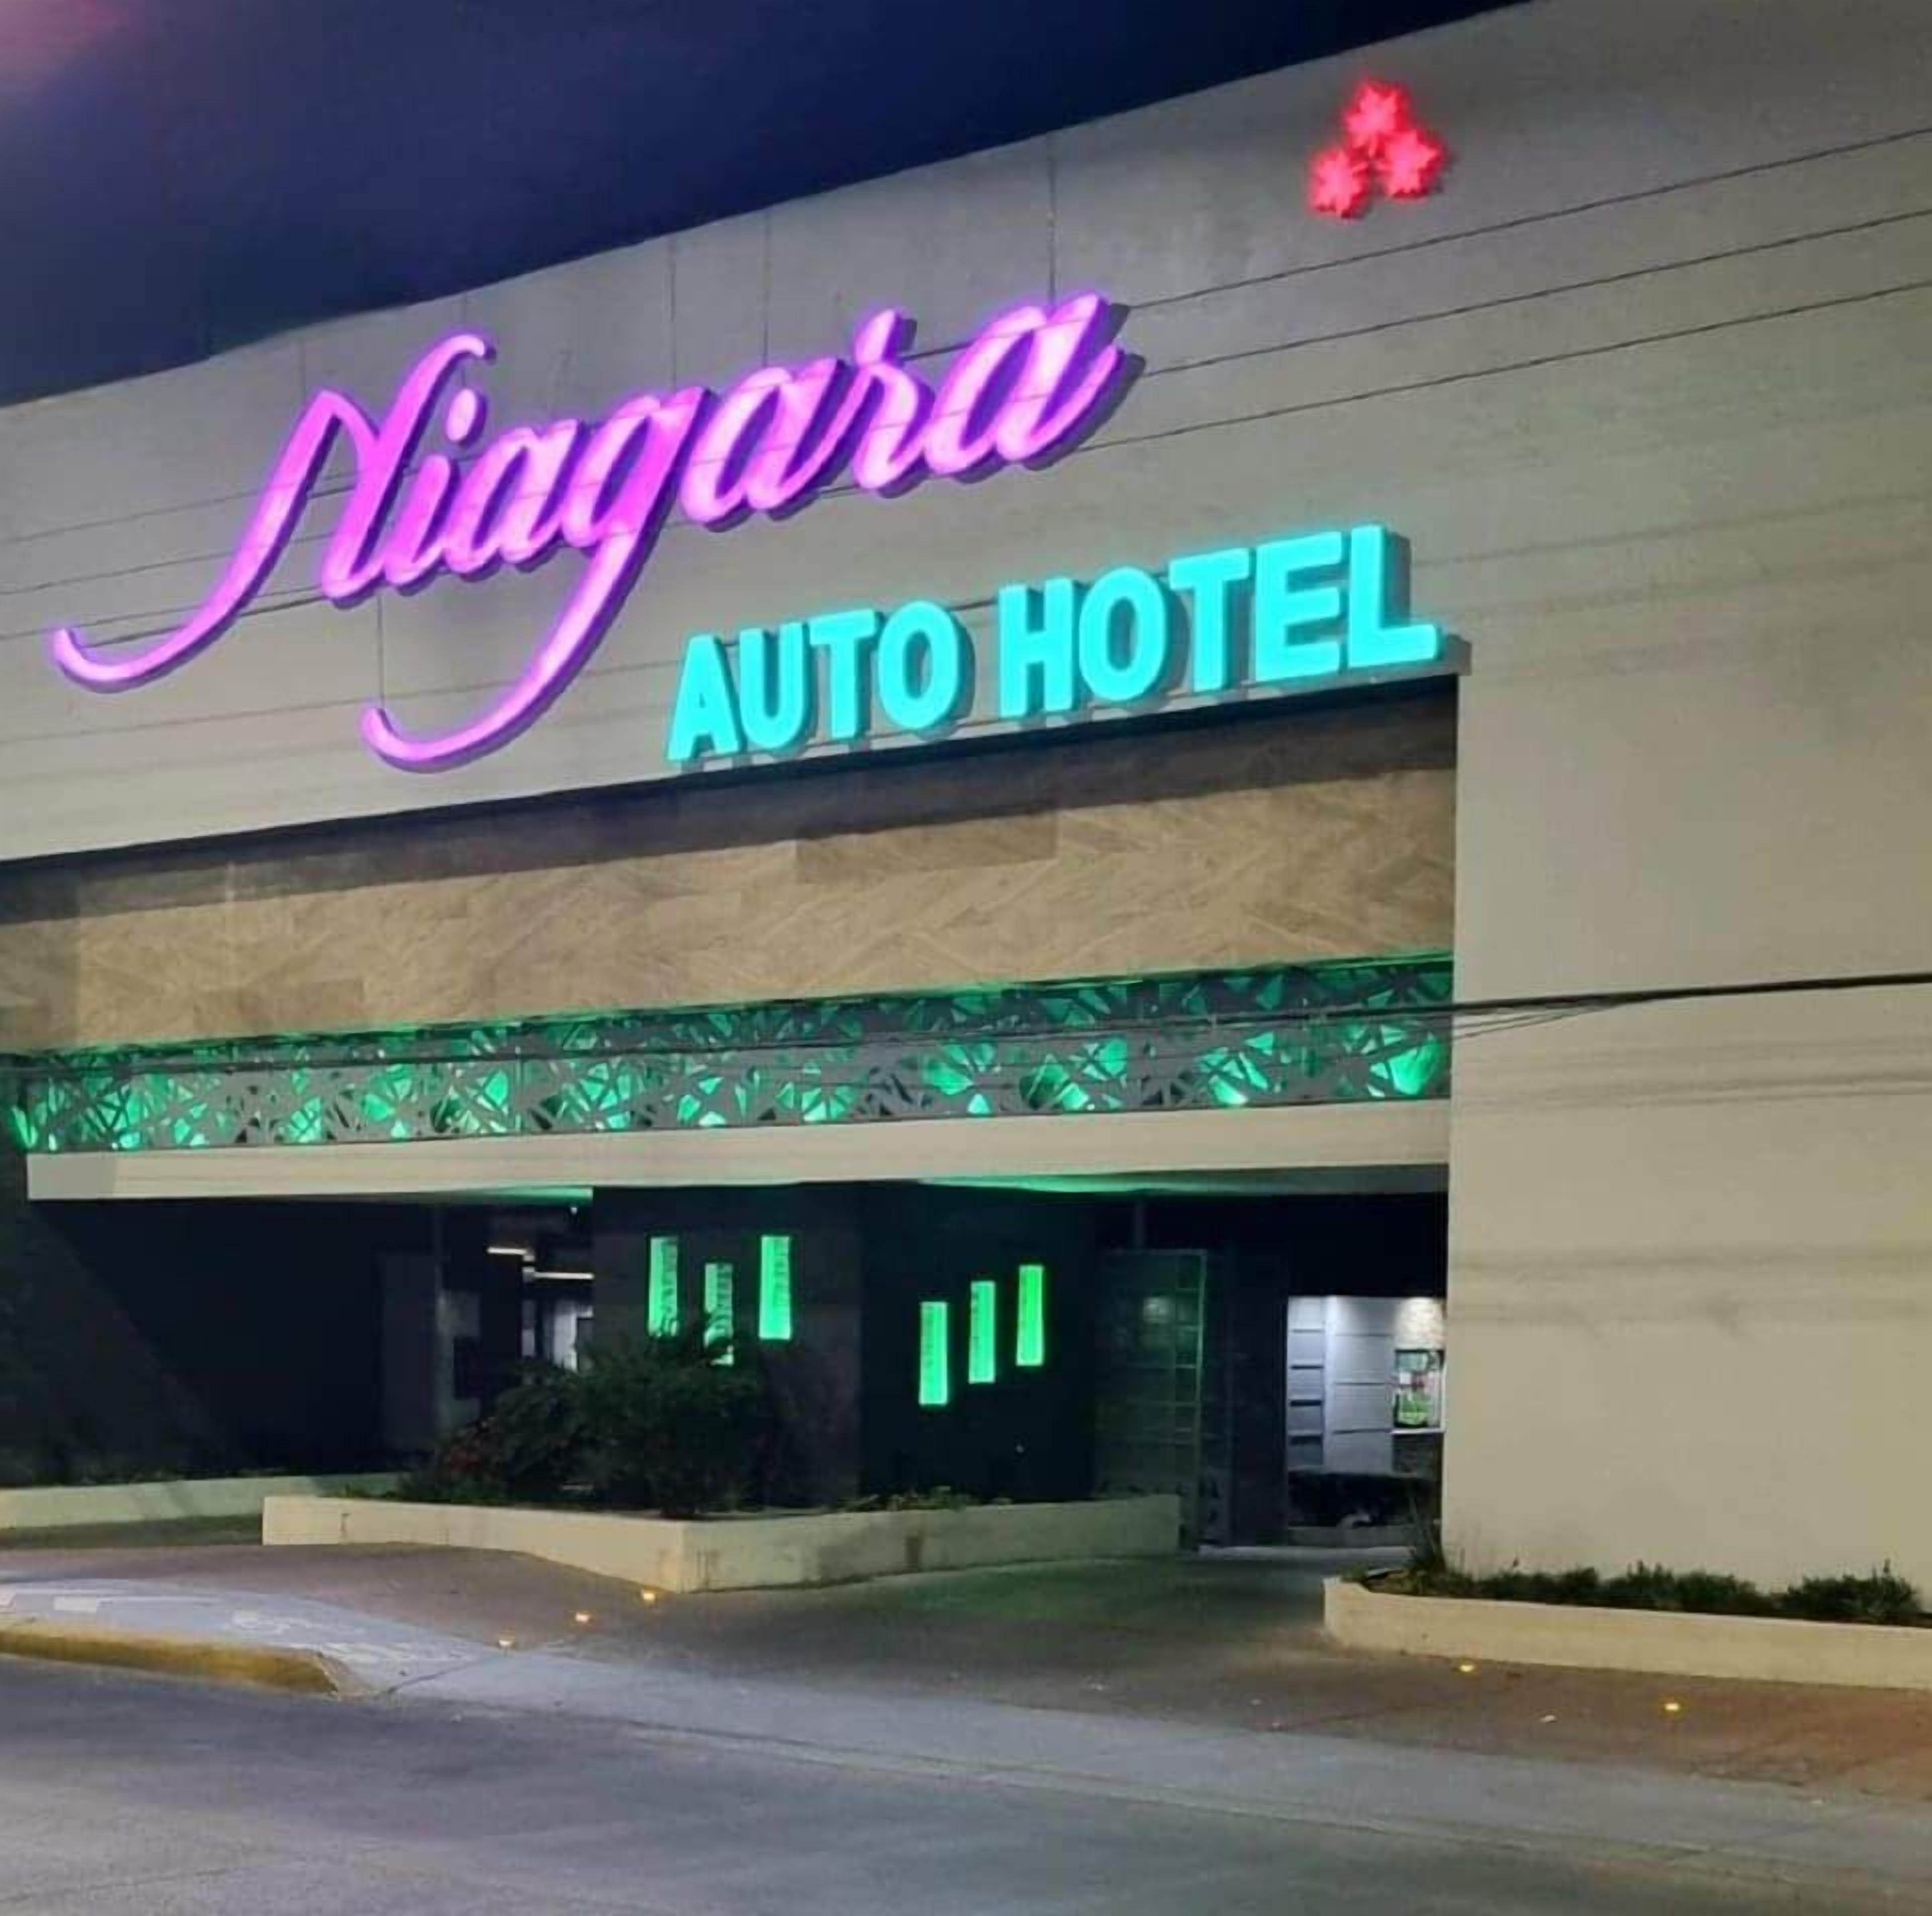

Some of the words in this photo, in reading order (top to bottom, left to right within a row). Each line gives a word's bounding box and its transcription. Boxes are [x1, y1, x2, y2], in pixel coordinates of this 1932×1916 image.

[51, 291, 1127, 768] Niagara
[666, 600, 960, 763] AUTO
[995, 523, 1442, 718] HOTEL
